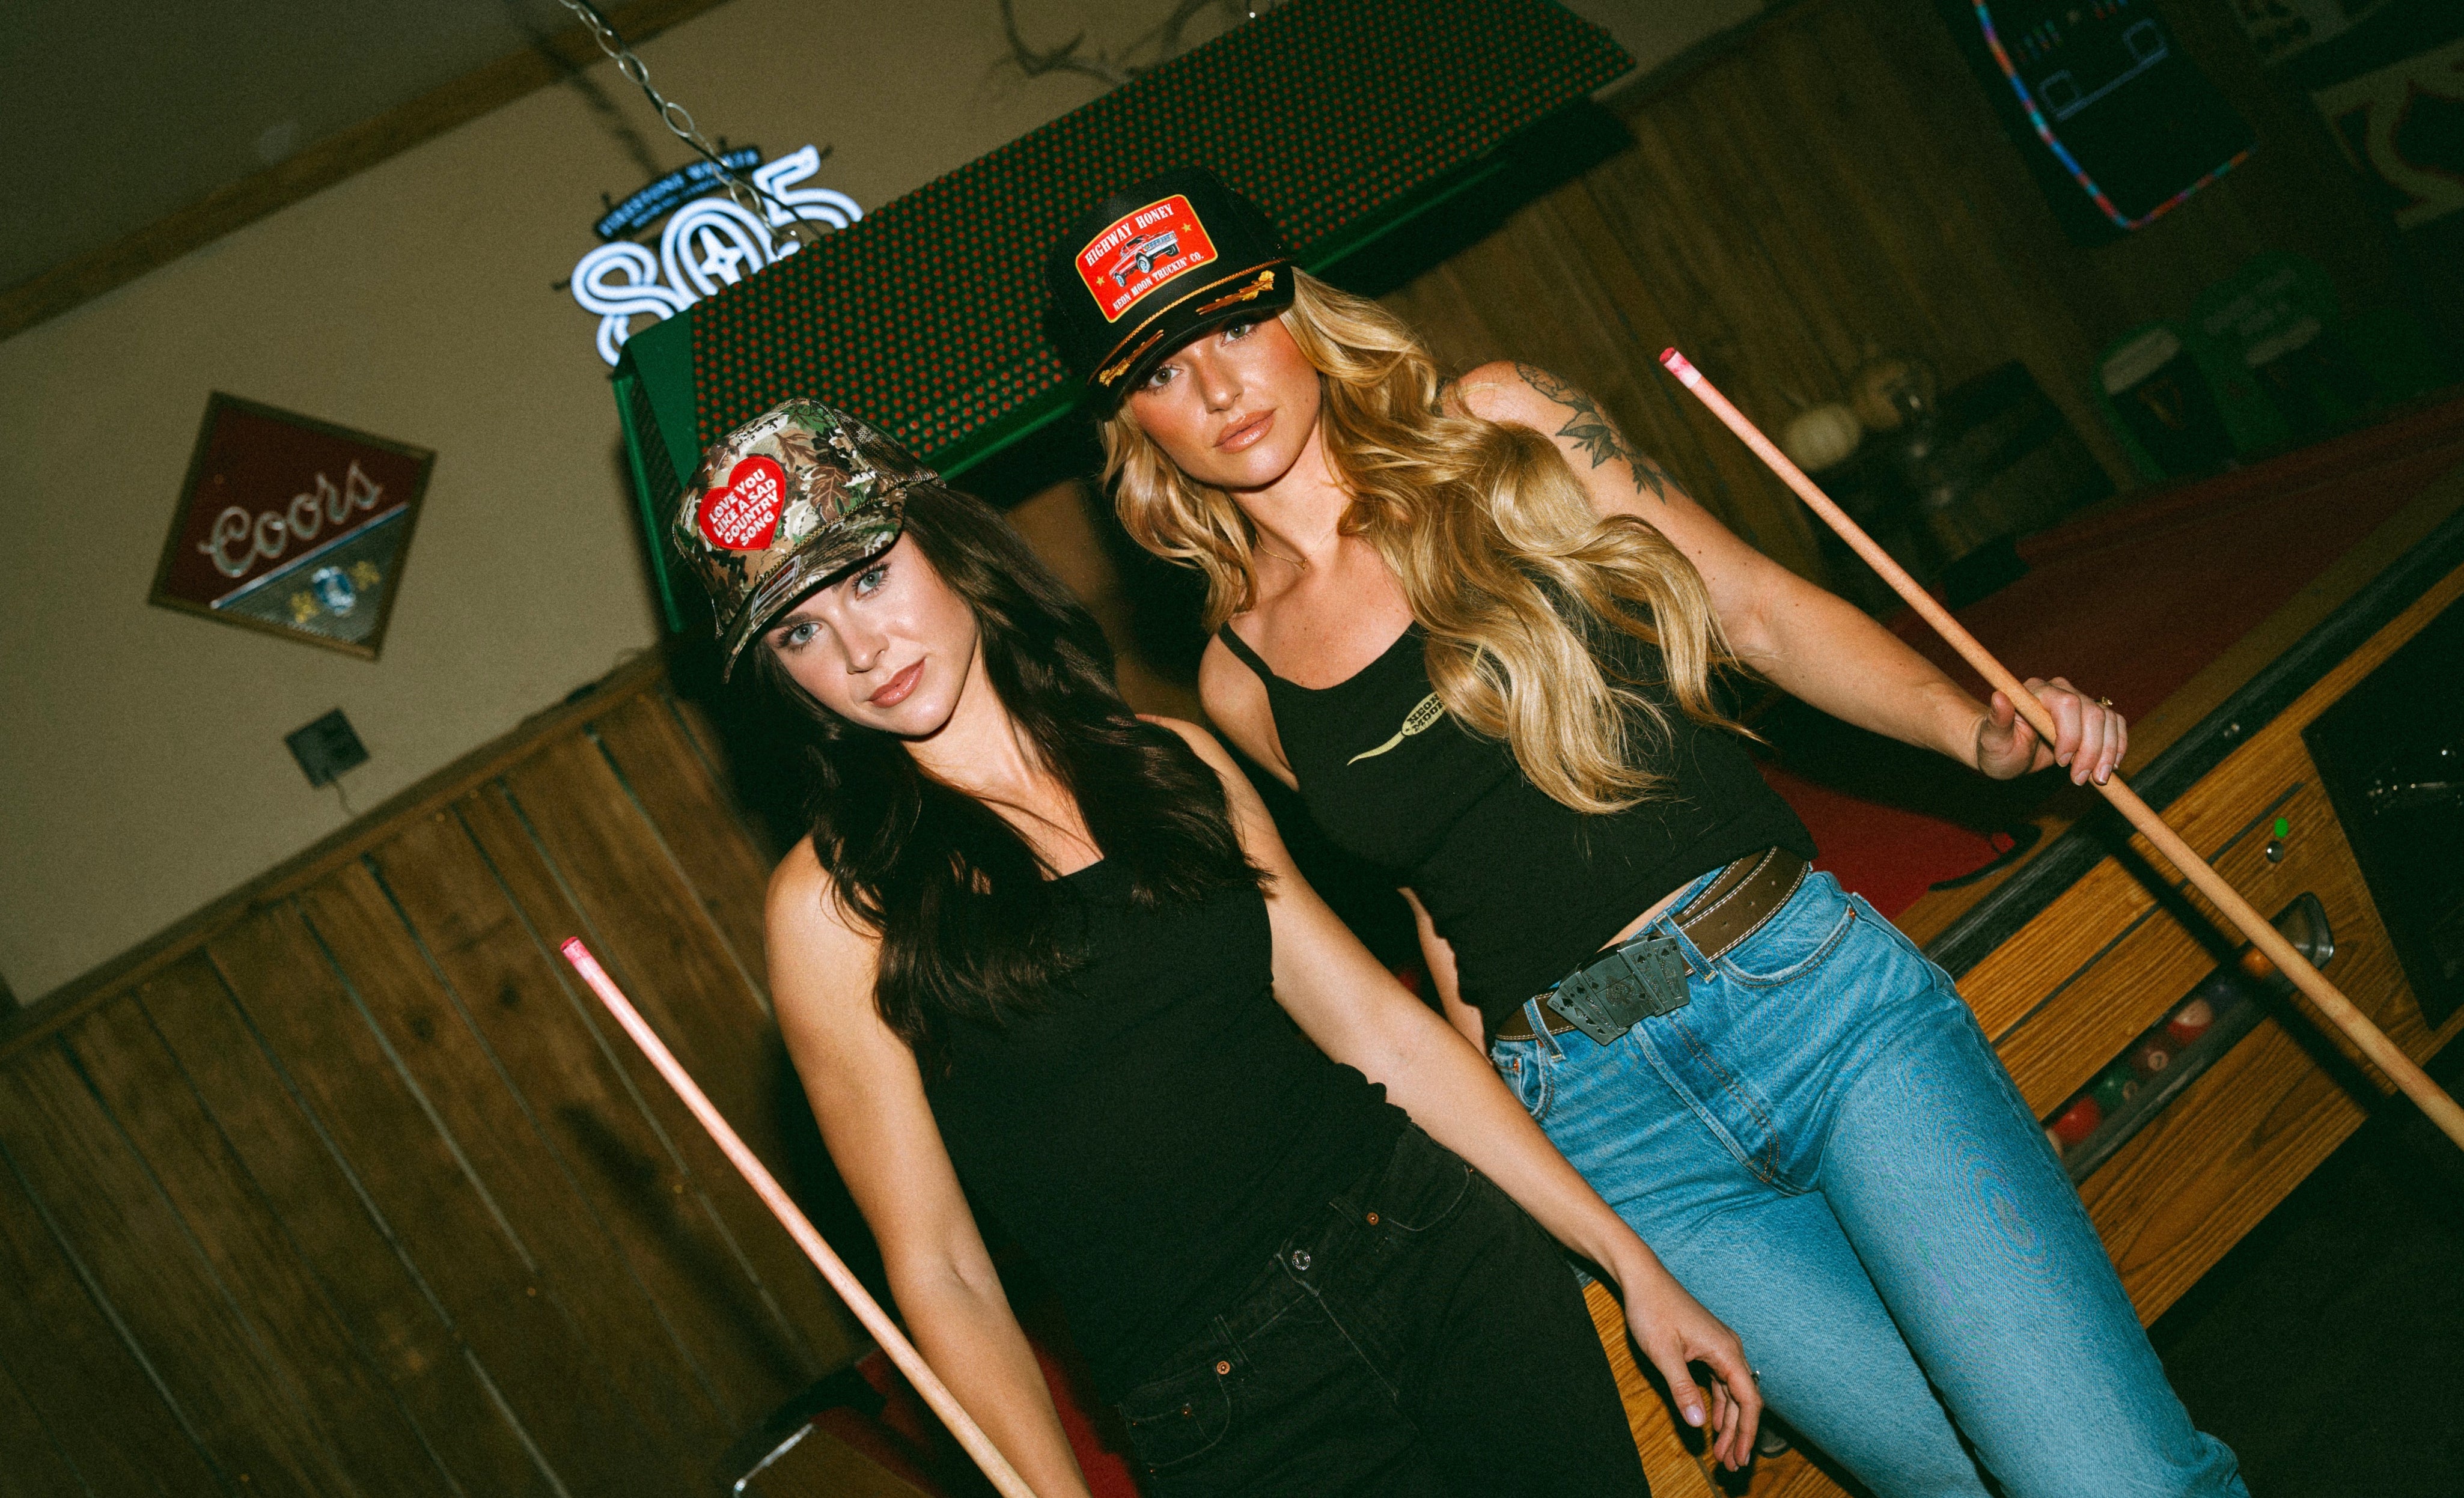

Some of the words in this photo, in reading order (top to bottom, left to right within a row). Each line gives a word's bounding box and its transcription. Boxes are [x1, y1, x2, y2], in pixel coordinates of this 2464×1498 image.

[1084, 223, 1132, 266] HIGHWAY
[1135, 204, 1174, 229] HONEY
[1112, 293, 1132, 311] NEON
[1130, 277, 1153, 296] MOON
[1190, 252, 1204, 263] CO.
[197, 461, 383, 578] Coors
[709, 492, 738, 524] LOVE
[734, 469, 766, 495] YOU
[713, 508, 739, 538] LIKE
[738, 499, 749, 513] A
[748, 479, 776, 505] SAD
[724, 490, 779, 544] COUNTRY
[739, 511, 775, 546] SONG
[1407, 694, 1441, 724] NEON
